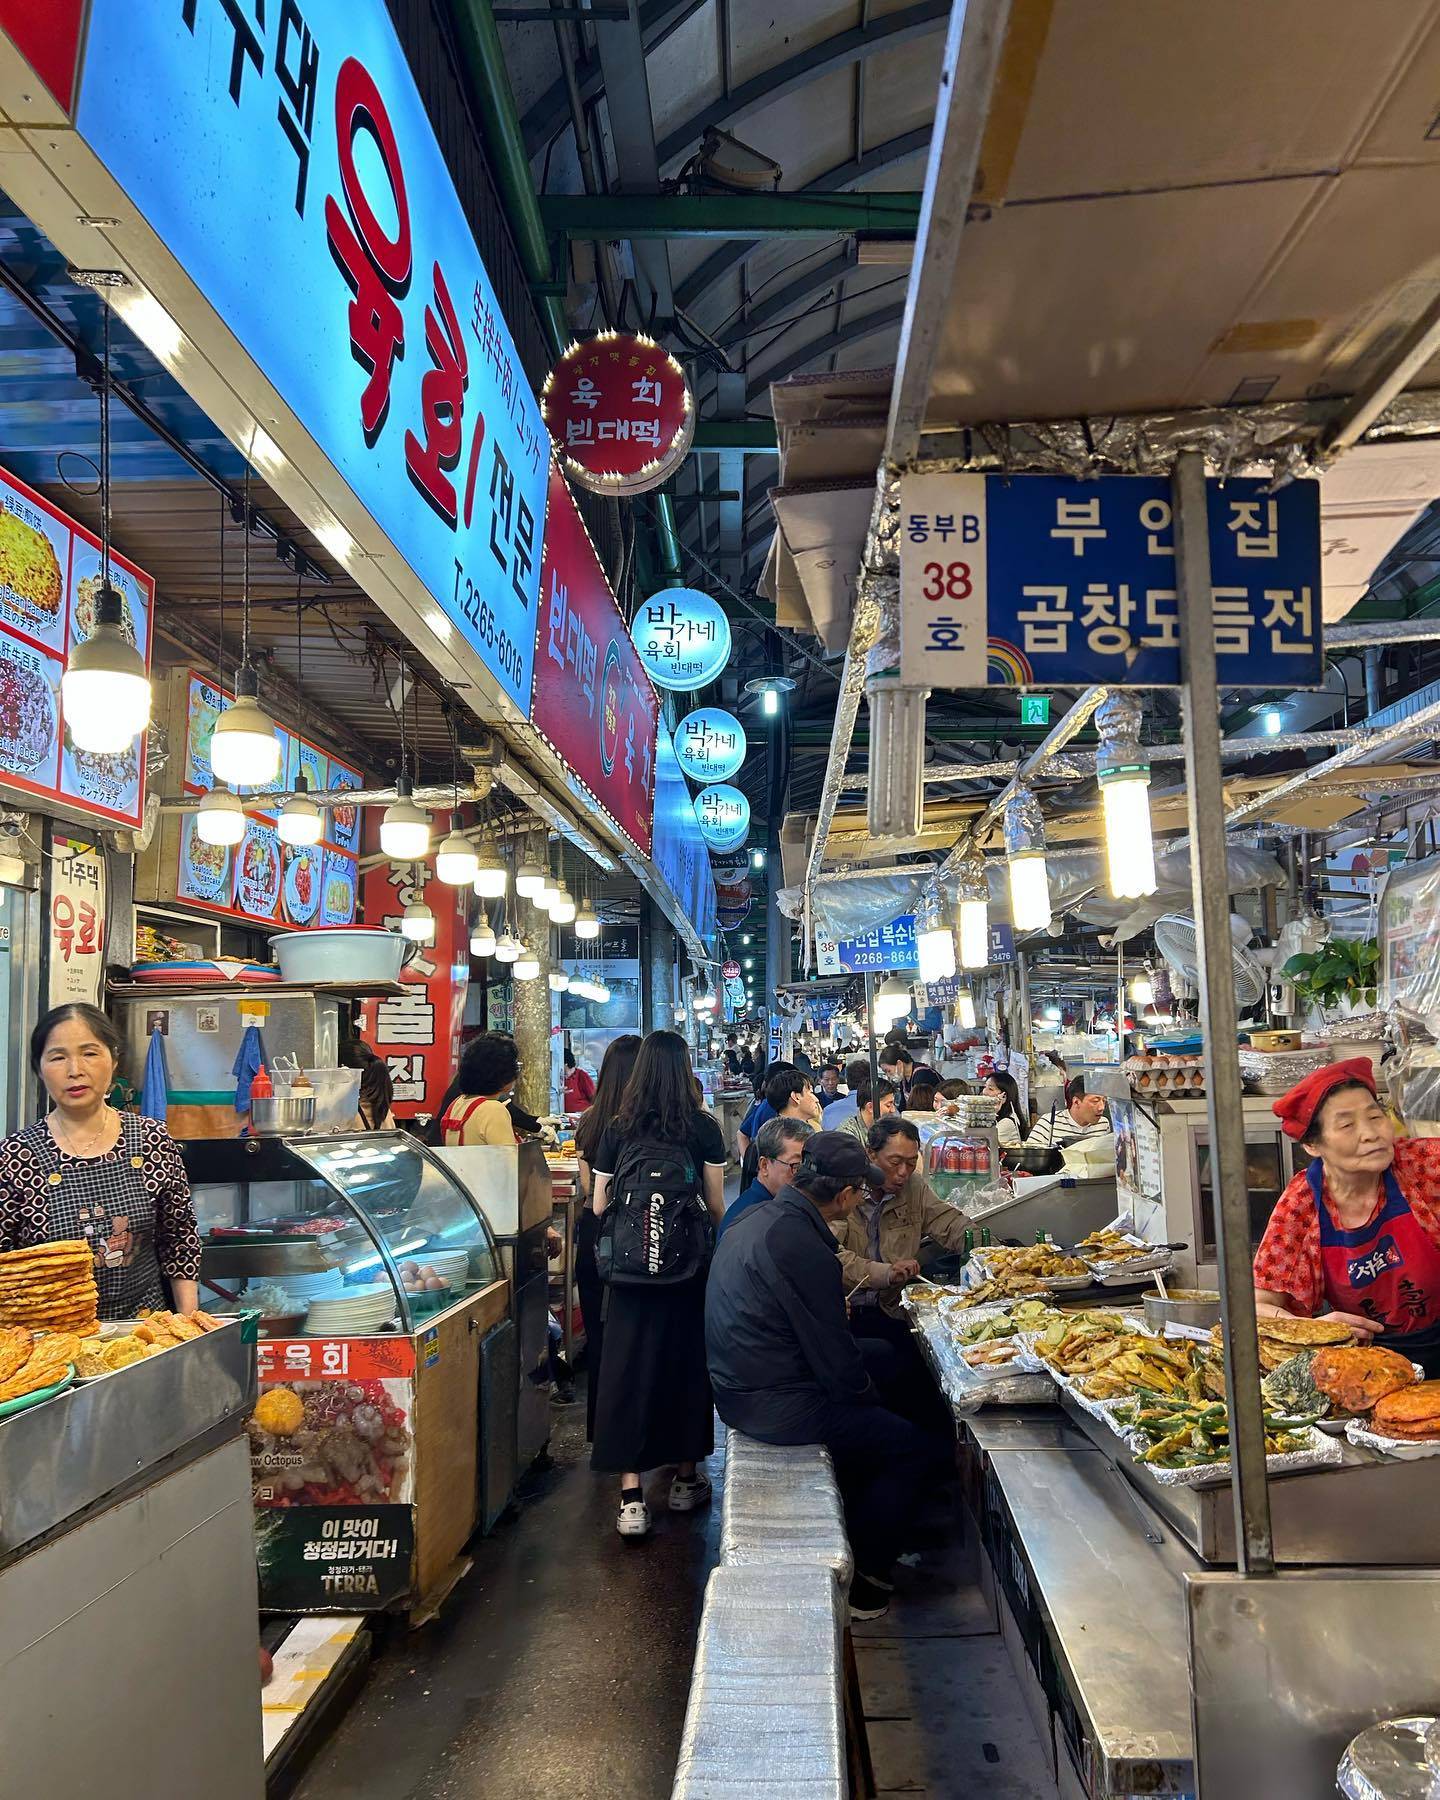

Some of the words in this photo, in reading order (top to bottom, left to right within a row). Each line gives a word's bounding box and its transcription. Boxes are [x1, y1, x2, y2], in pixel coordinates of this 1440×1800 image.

[566, 417, 662, 447] 빈대떡
[487, 437, 537, 612] 전문
[906, 513, 980, 545] 동부B
[923, 561, 973, 601] 38
[454, 556, 523, 690] T.2265-6016
[646, 603, 716, 641] 박가네
[924, 616, 965, 652] 호
[549, 568, 598, 719] 빈대떡
[643, 639, 680, 662] 육회
[670, 661, 703, 675] 빈대떡
[685, 720, 736, 749] 박가네
[682, 747, 710, 763] 육회
[701, 793, 742, 816] 박가네
[61, 857, 99, 890] 나주댁
[53, 894, 105, 963] 육회
[820, 941, 835, 952] 38
[648, 1192, 665, 1273] California
[264, 1455, 303, 1467] Octopus
[322, 1519, 339, 1539] 이
[343, 1519, 379, 1538] 맛이
[303, 1540, 398, 1561] 청정라거다!
[321, 1573, 380, 1595] TERRA
